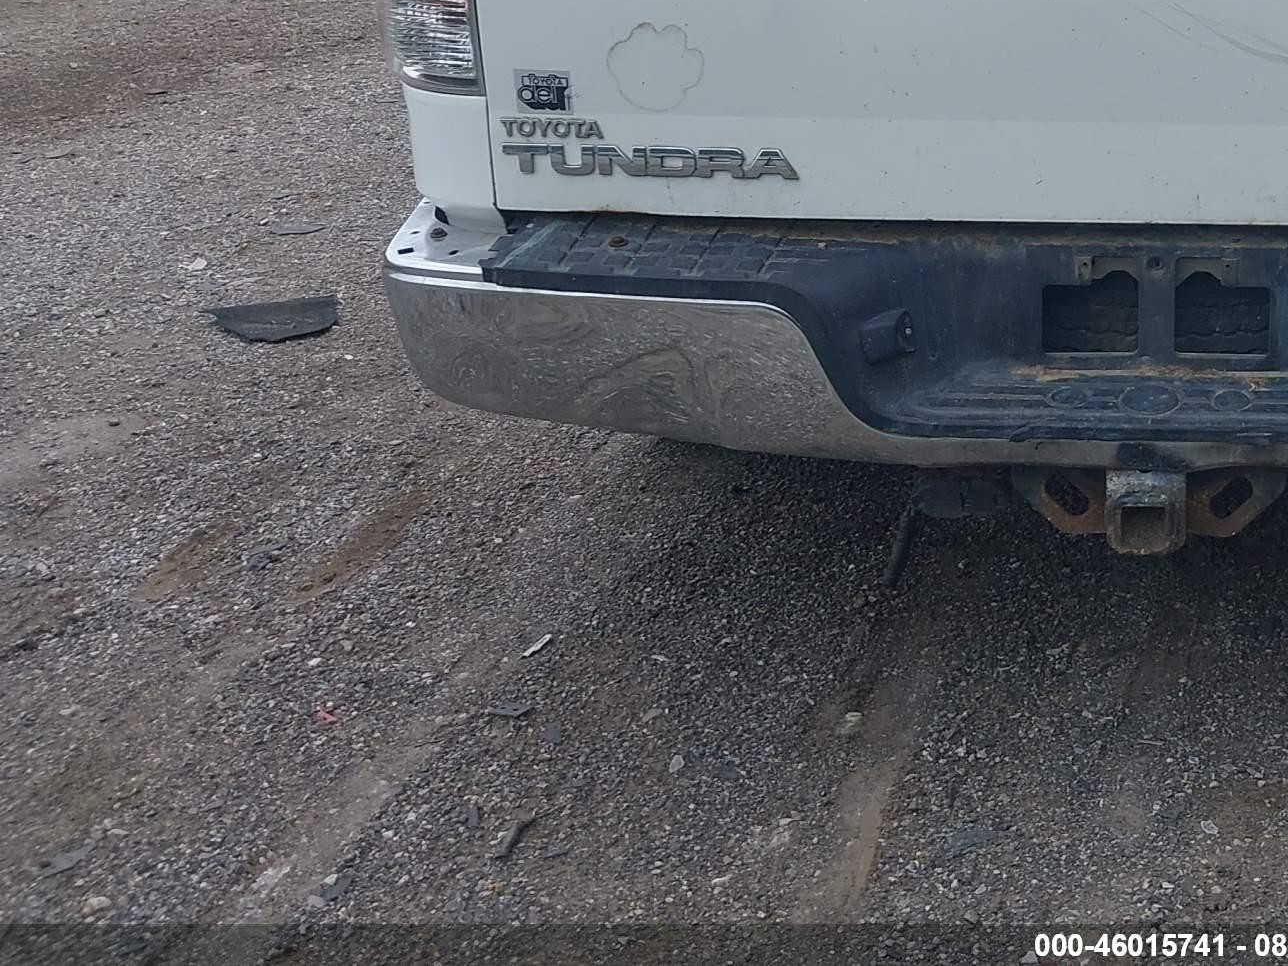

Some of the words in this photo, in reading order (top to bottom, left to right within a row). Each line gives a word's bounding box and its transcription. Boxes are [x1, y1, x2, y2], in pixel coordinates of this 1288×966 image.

[525, 74, 564, 85] TOYOTA
[500, 117, 604, 139] TOYOTA
[501, 142, 800, 180] TUNDRA
